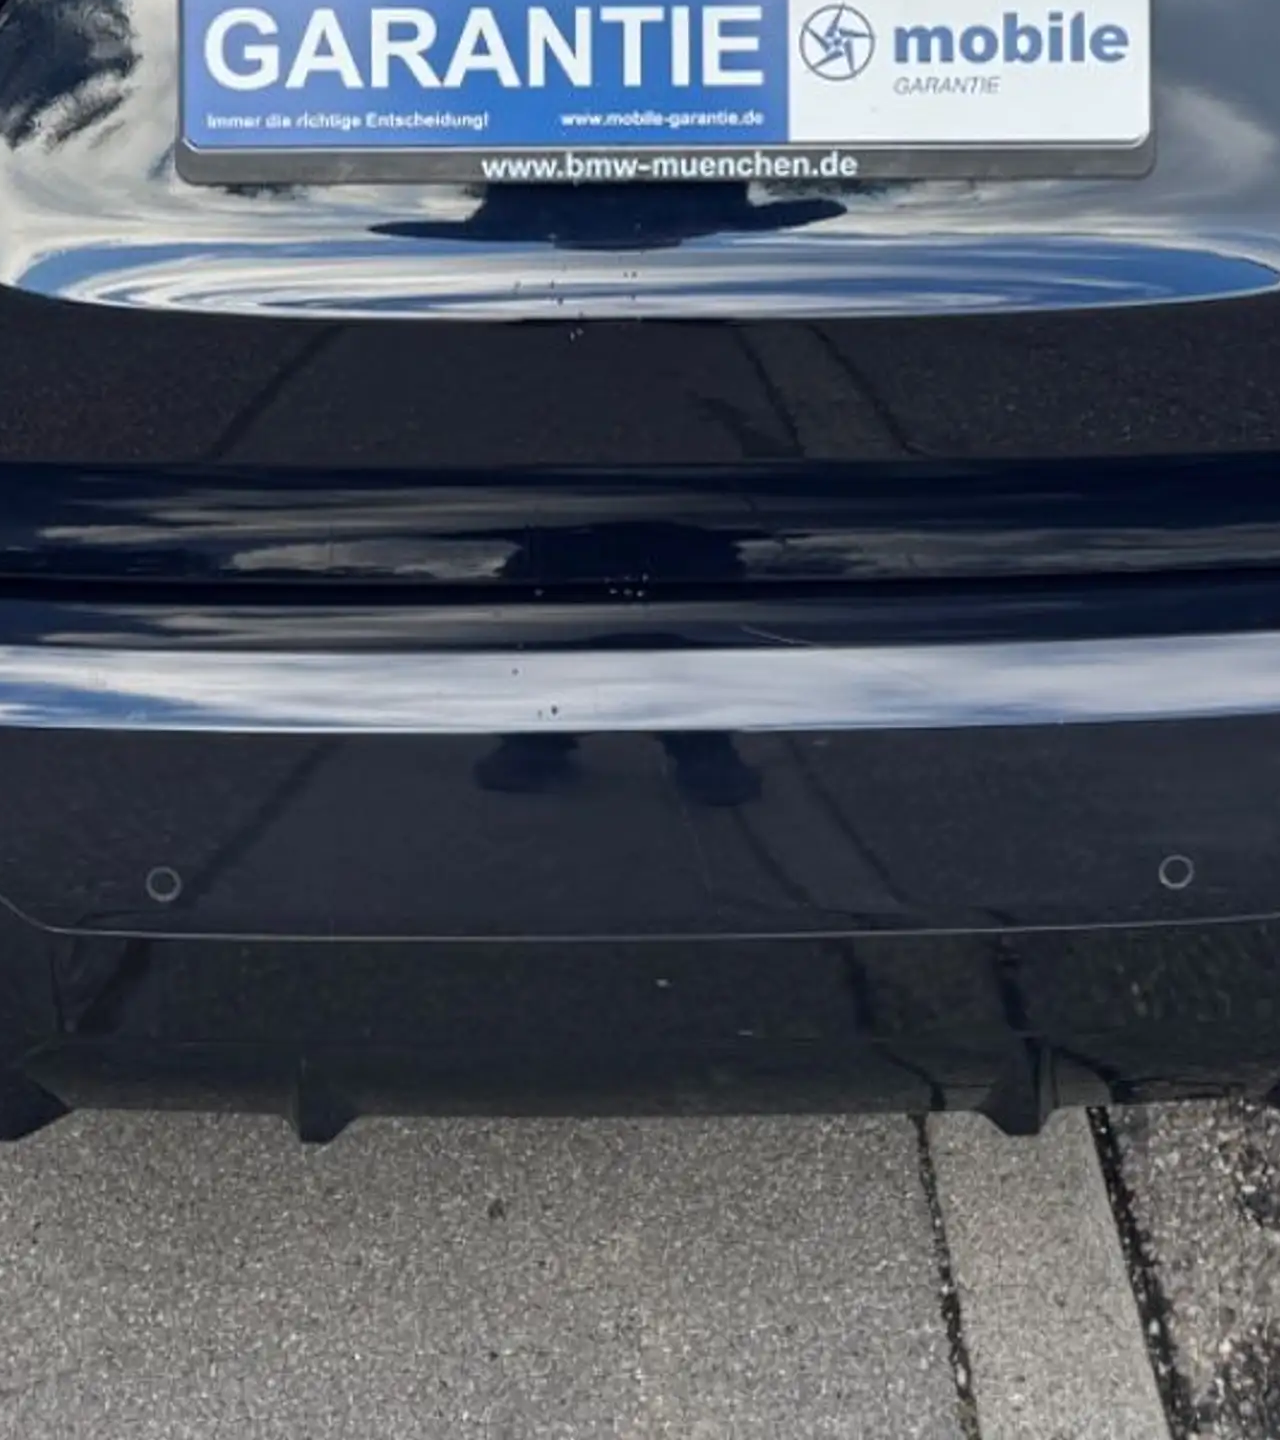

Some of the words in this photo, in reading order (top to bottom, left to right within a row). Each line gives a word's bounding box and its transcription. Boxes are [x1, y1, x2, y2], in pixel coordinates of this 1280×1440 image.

[204, 5, 765, 91] GARANTIE
[894, 11, 1130, 64] mobile
[894, 76, 1002, 95] GARANTIE
[207, 113, 260, 129] Immer
[265, 113, 292, 129] die
[296, 113, 362, 131] richtige
[366, 111, 490, 131] Entscheidung!
[561, 111, 764, 129] www.mobile-garantie.de
[481, 151, 859, 182] www.bmw-muenchen.de
